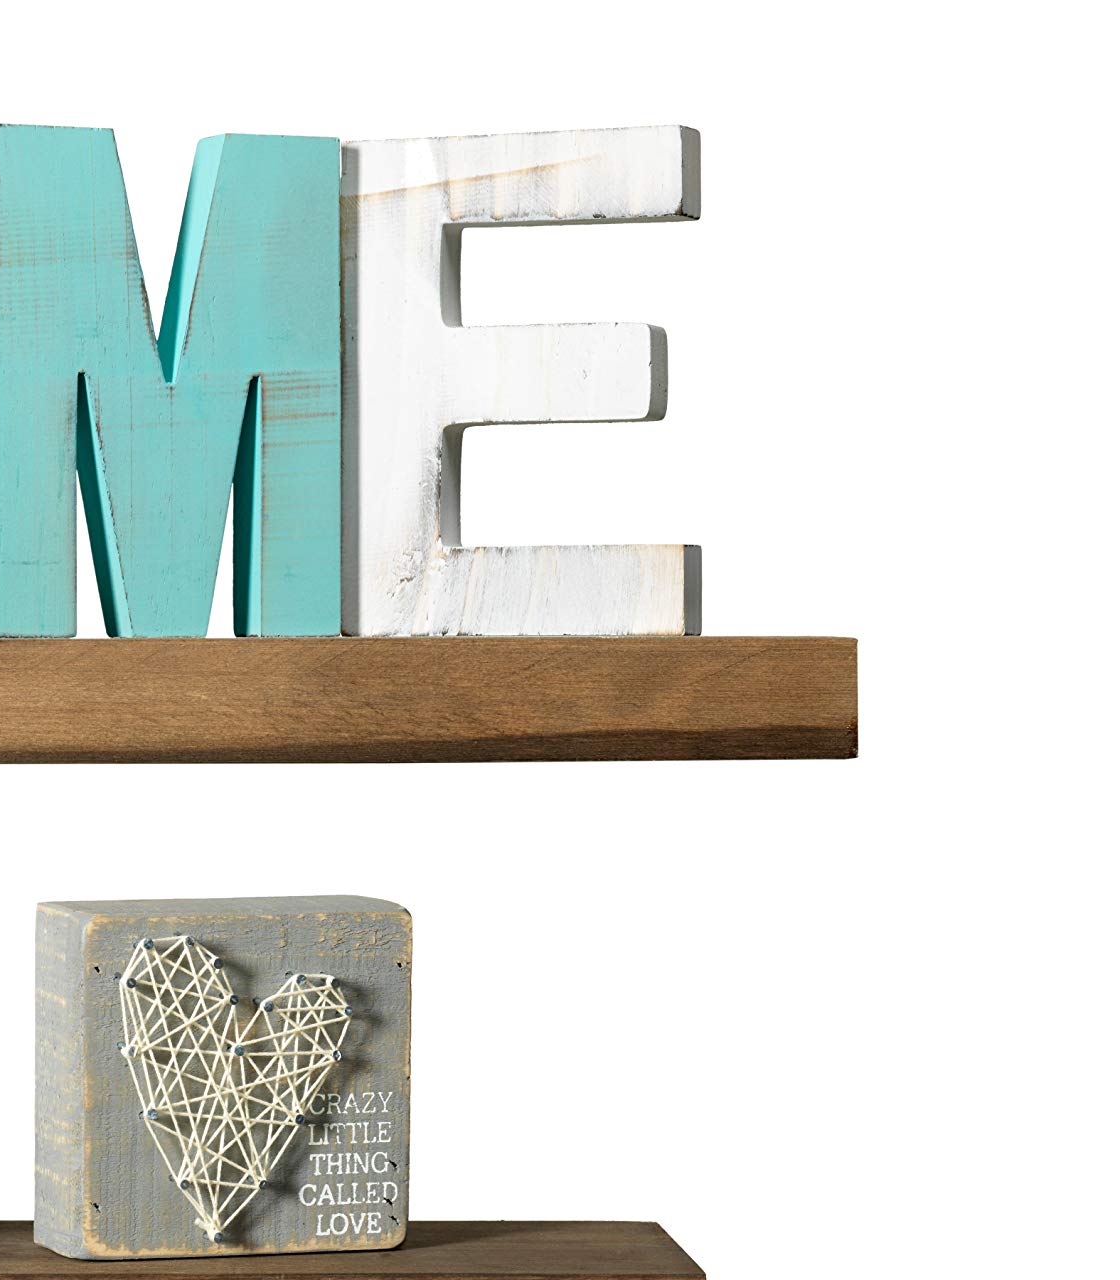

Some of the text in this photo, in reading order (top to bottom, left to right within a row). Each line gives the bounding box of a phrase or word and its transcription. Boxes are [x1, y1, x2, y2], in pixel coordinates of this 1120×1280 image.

[309, 1092, 393, 1115] CRAZY
[308, 1121, 391, 1146] LITTLE
[309, 1152, 389, 1176] THING
[298, 1181, 398, 1206] CALLED
[316, 1212, 382, 1236] LOVE
